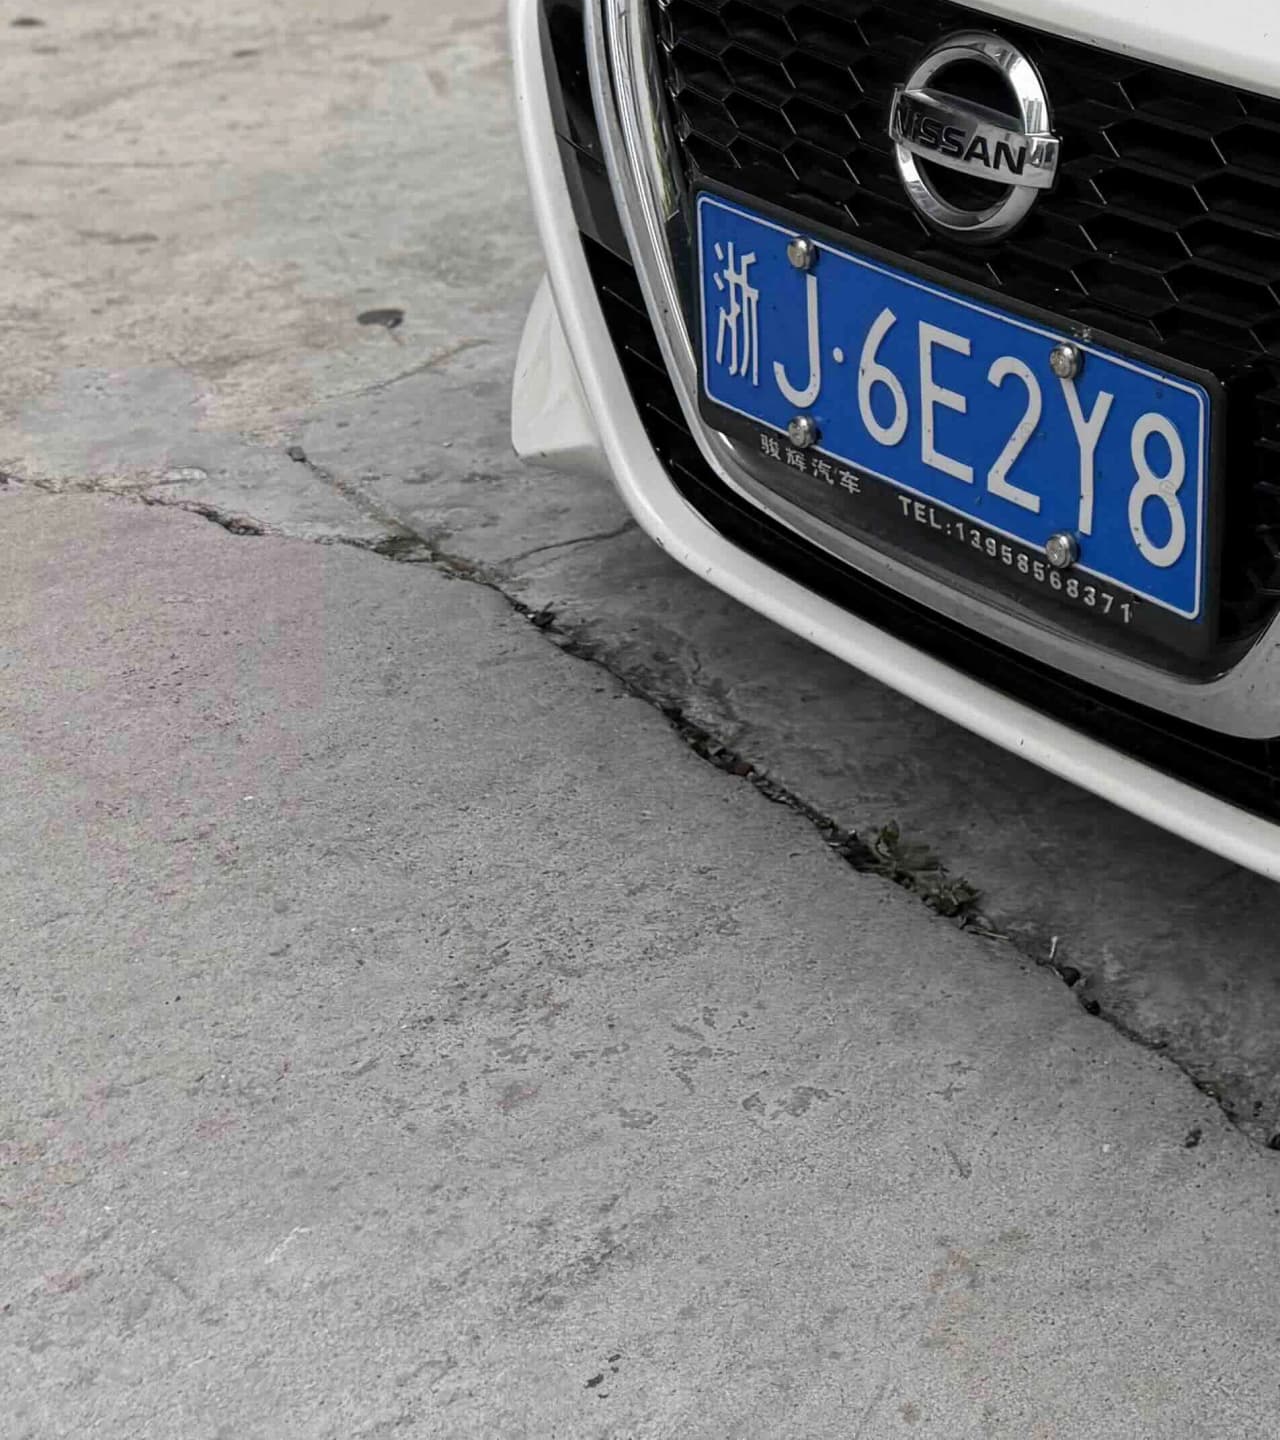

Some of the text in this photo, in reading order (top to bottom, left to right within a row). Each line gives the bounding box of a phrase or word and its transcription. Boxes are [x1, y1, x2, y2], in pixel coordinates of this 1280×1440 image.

[895, 100, 1027, 176] NISSAN
[760, 434, 861, 494] 骏辉汽车
